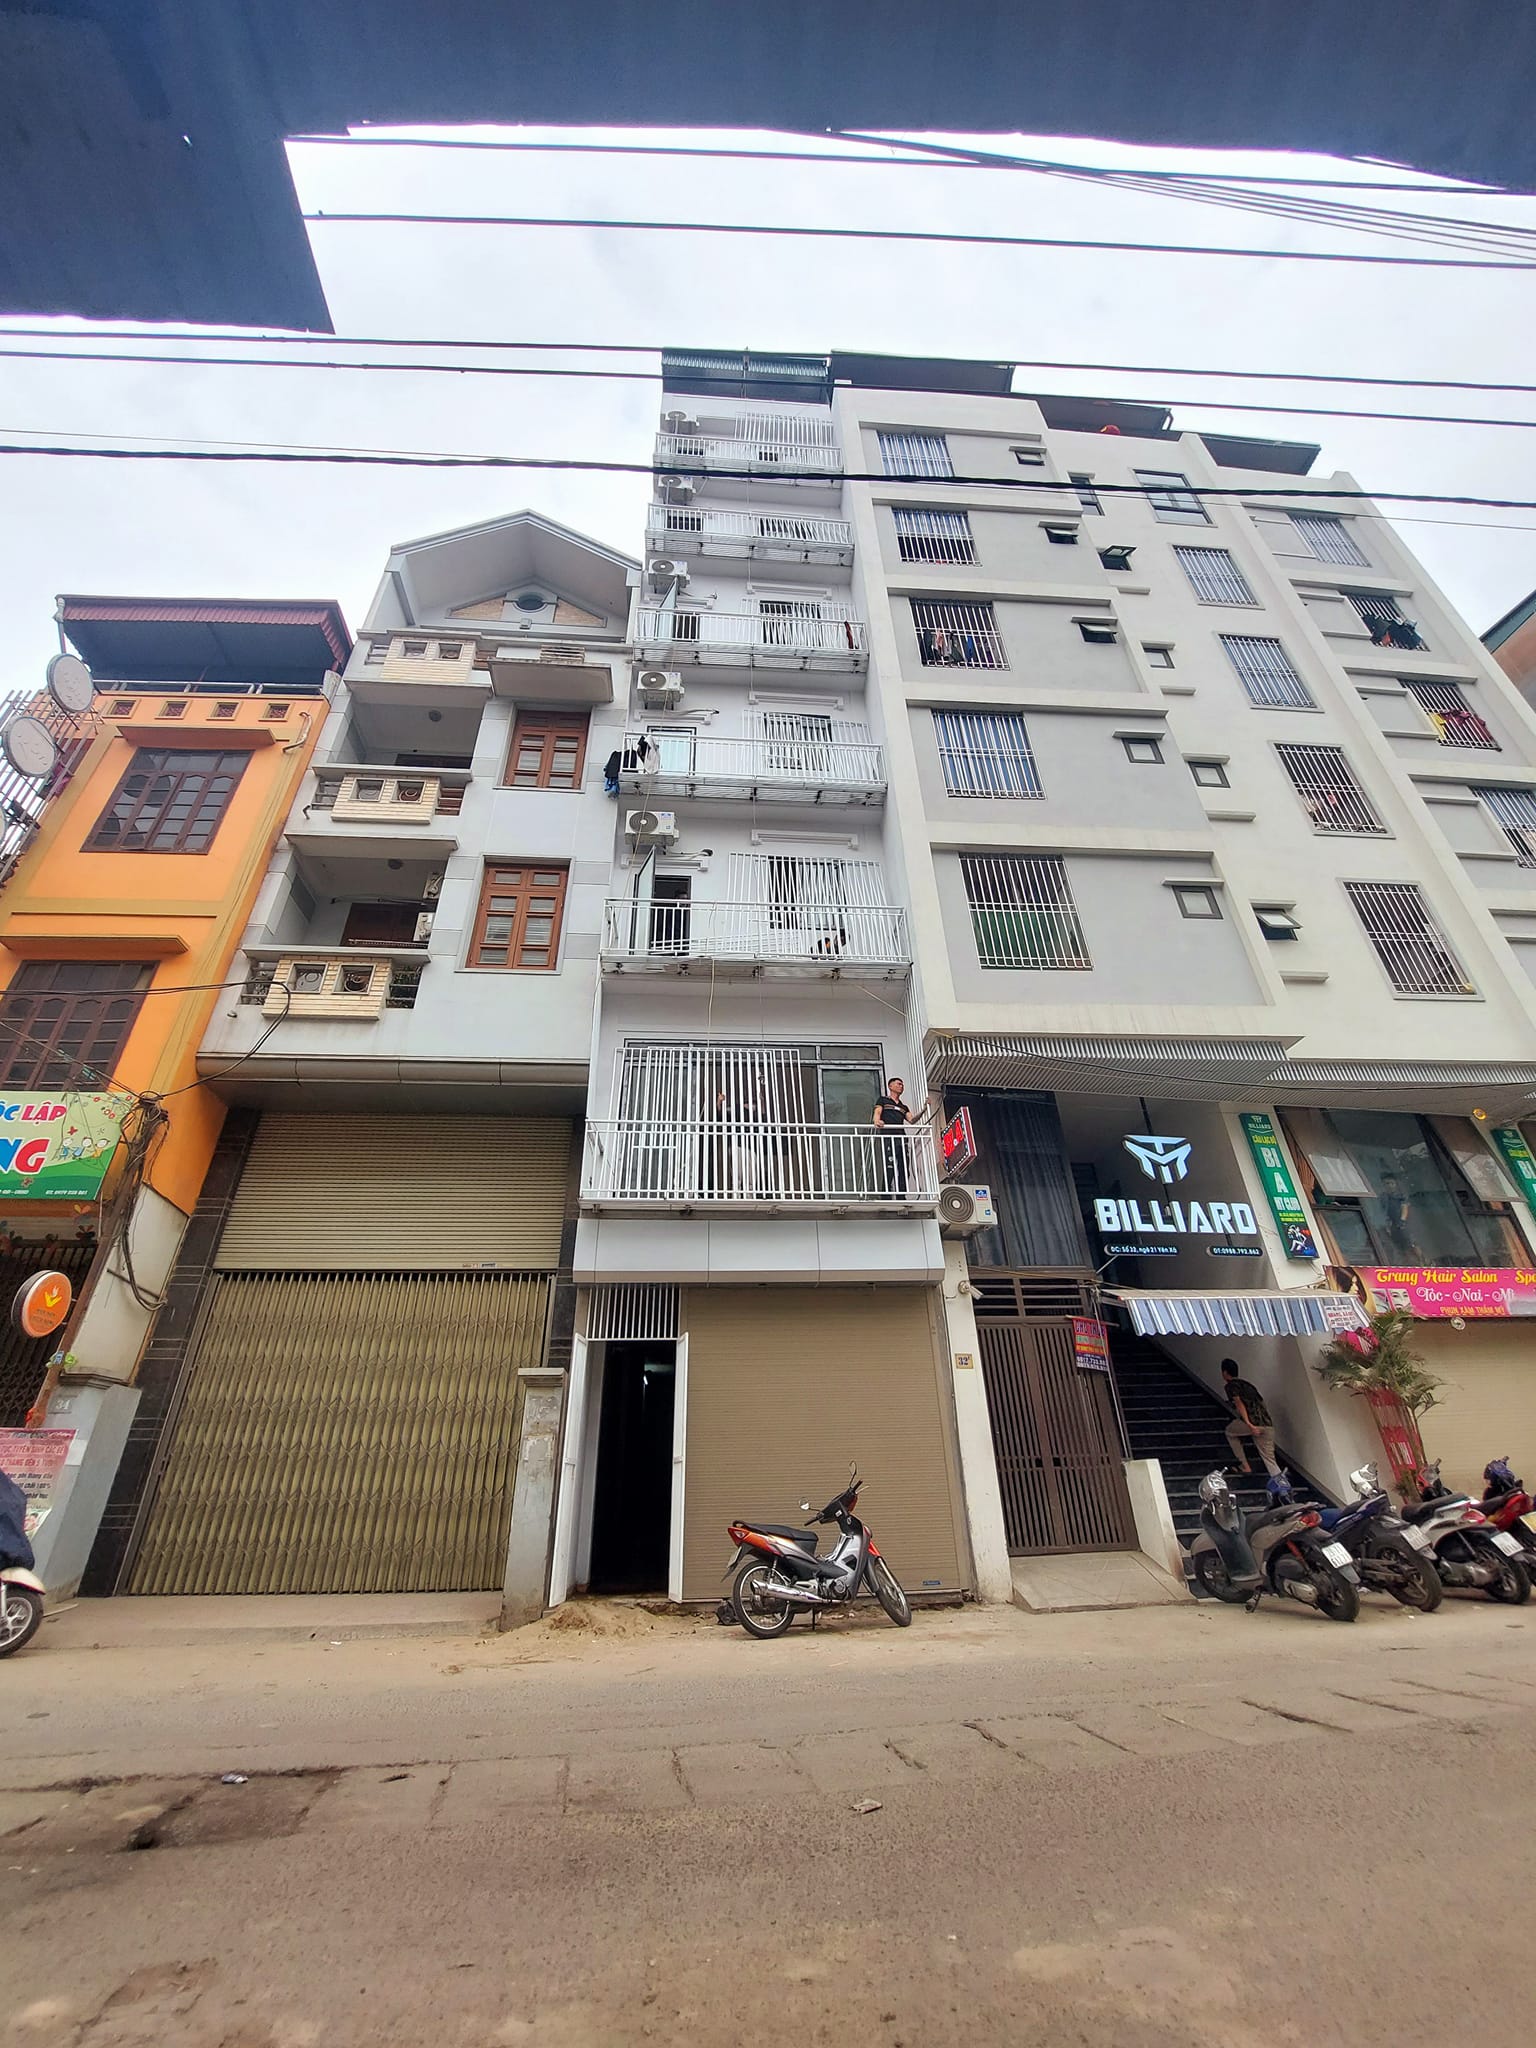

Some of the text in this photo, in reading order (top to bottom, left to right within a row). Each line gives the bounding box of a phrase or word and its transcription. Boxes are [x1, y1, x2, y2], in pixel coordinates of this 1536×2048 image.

[21, 1100, 67, 1125] LẬP
[1260, 1147, 1282, 1168] BI
[1273, 1172, 1289, 1193] A
[1094, 1198, 1258, 1235] BILLIARD
[1375, 1269, 1418, 1286] Trang
[1422, 1270, 1456, 1283] Hair
[1461, 1269, 1498, 1283] Salon
